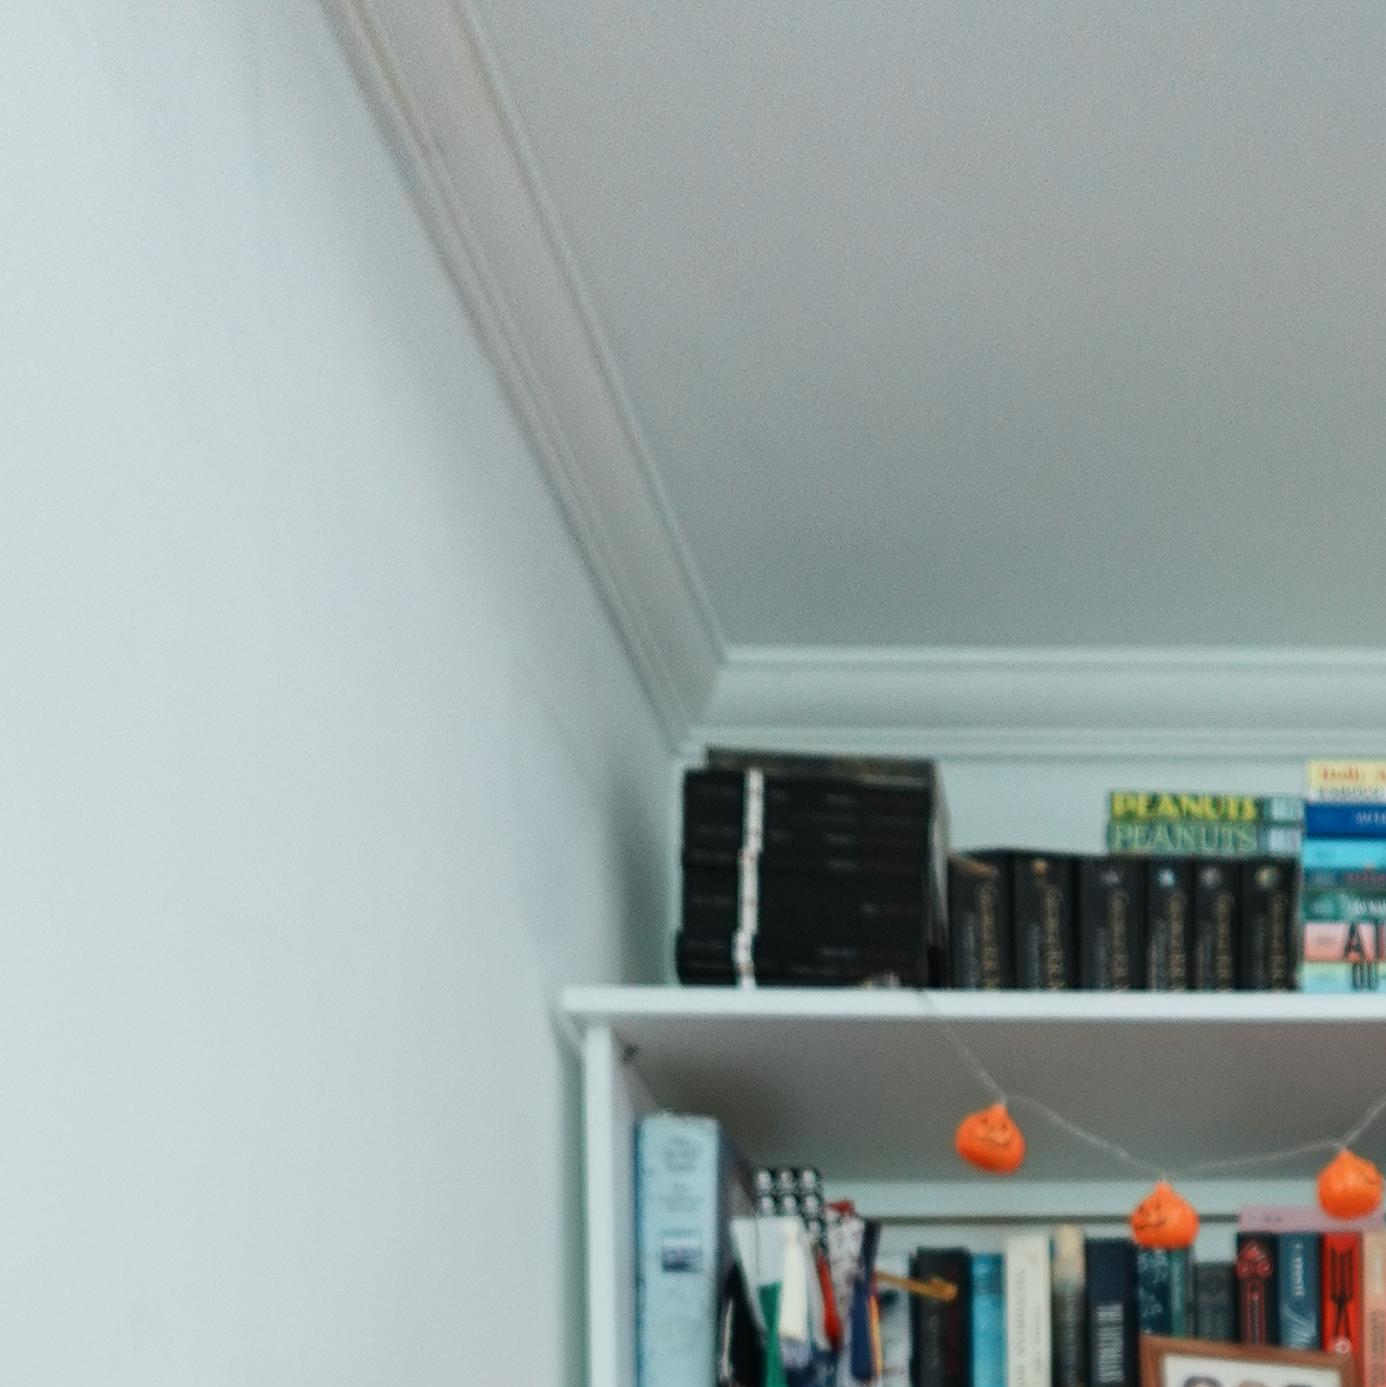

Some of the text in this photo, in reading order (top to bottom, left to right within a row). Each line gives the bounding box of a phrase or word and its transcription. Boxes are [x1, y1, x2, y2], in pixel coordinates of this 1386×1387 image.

[1110, 793, 1257, 820] PEANUTS
[1111, 824, 1257, 852] PEANUTS
[1344, 923, 1366, 961] A
